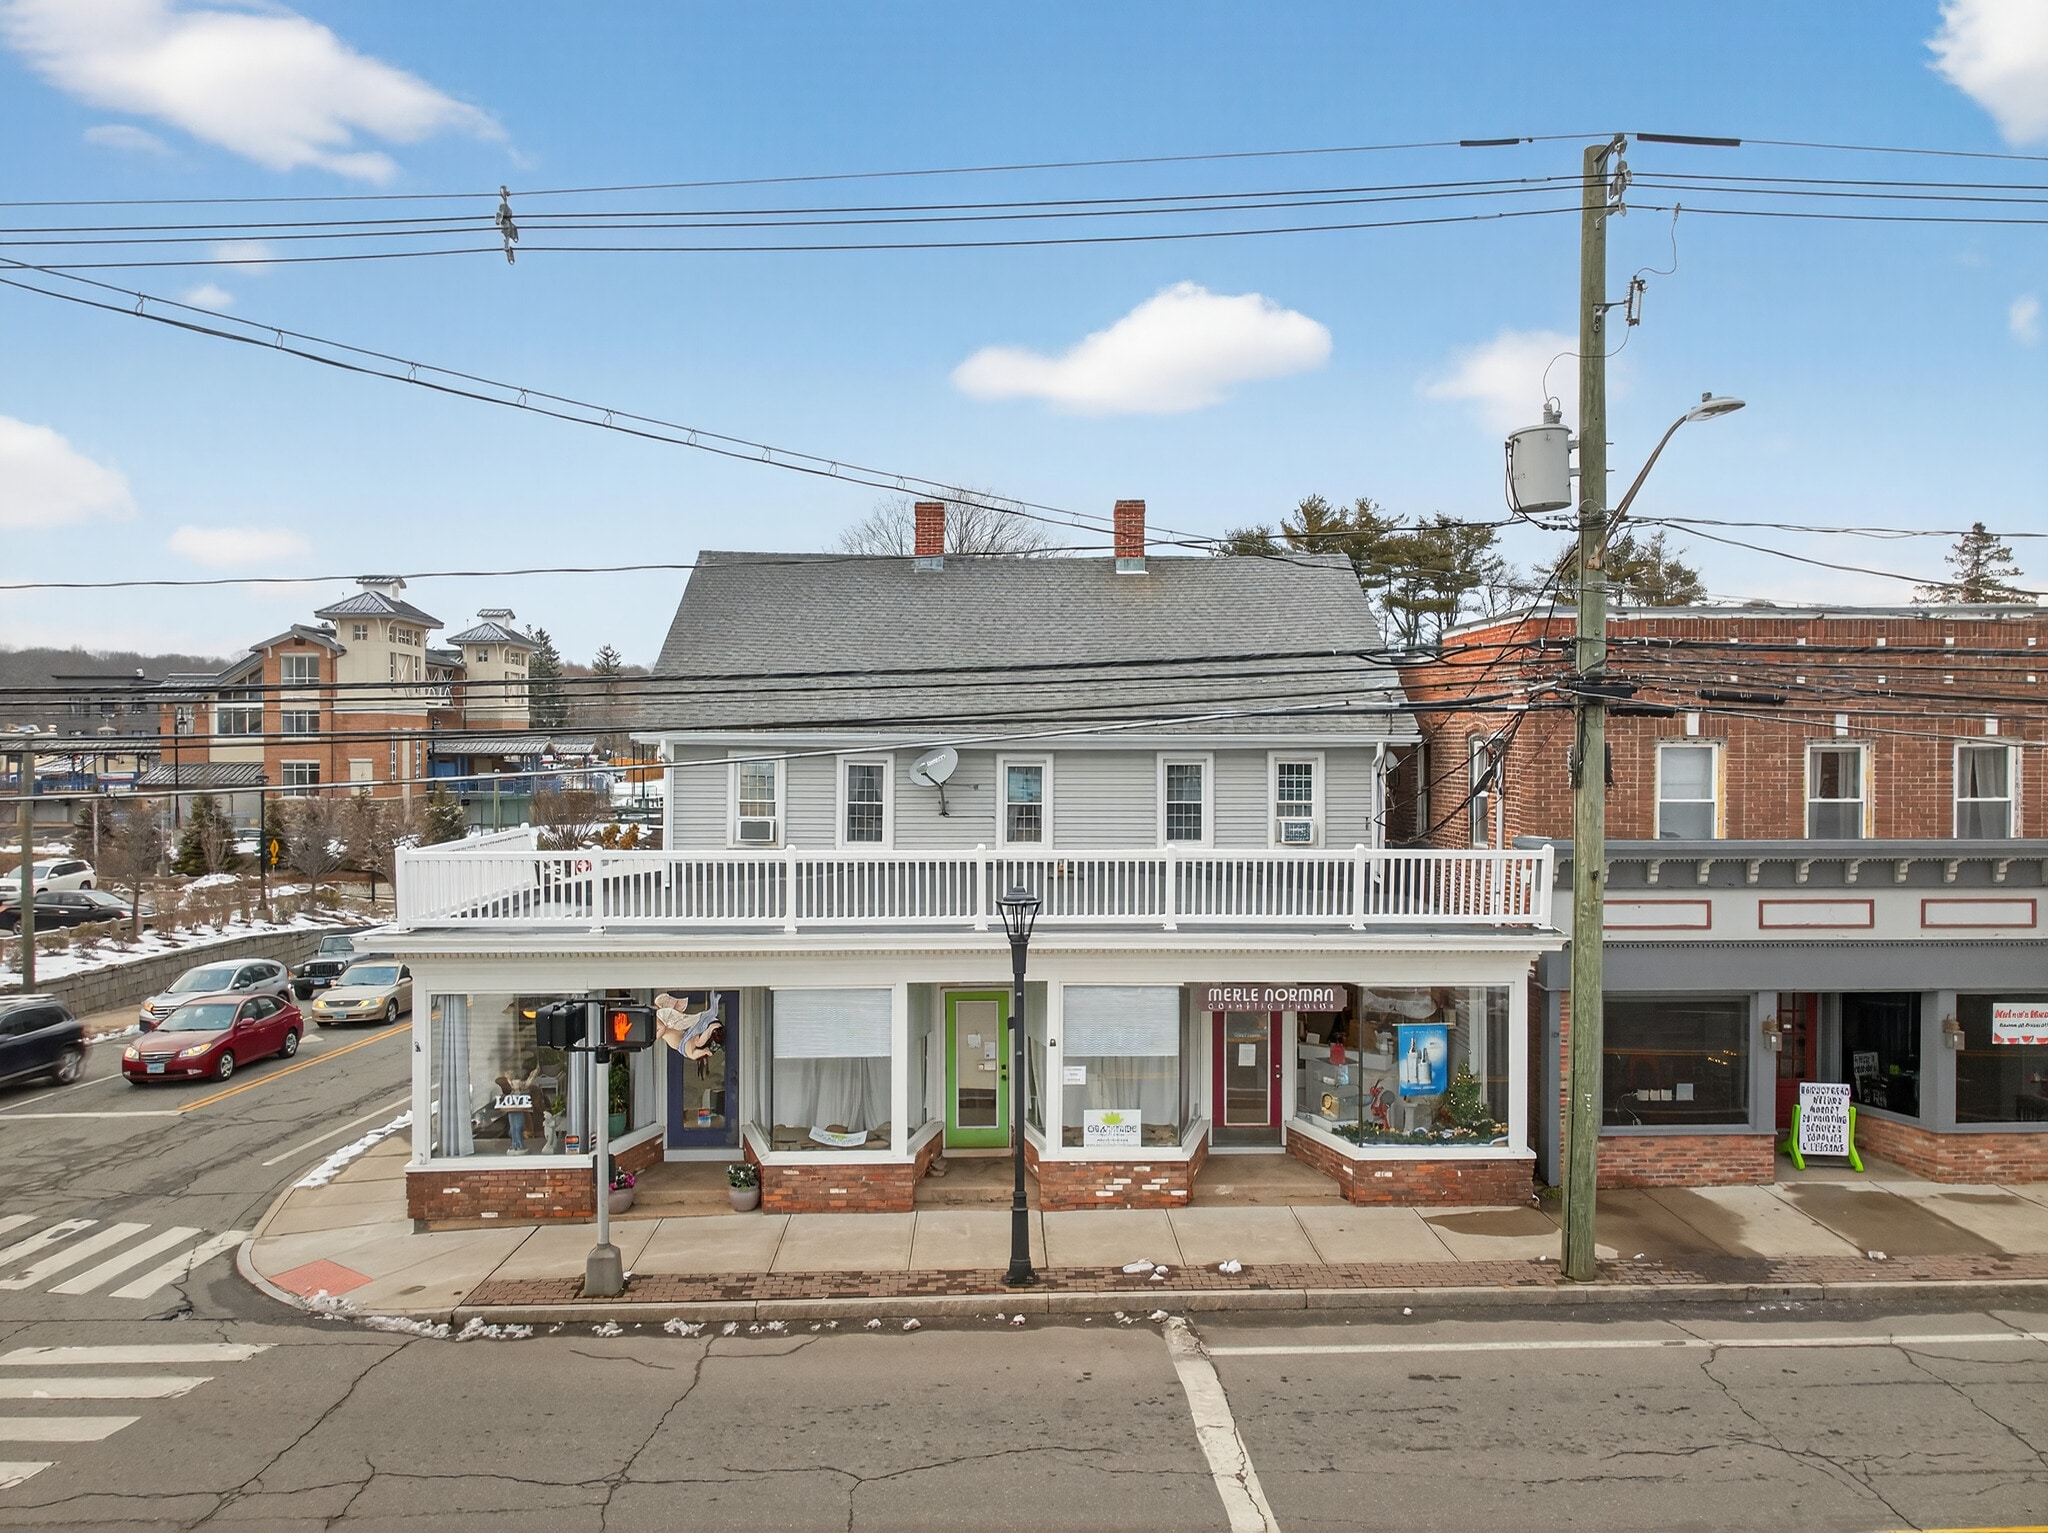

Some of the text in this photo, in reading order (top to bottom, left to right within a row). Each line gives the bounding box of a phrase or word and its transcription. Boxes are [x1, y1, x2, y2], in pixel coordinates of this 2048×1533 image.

[1208, 987, 1334, 1002] MERLE NORMAN
[494, 1094, 532, 1109] LOVE
